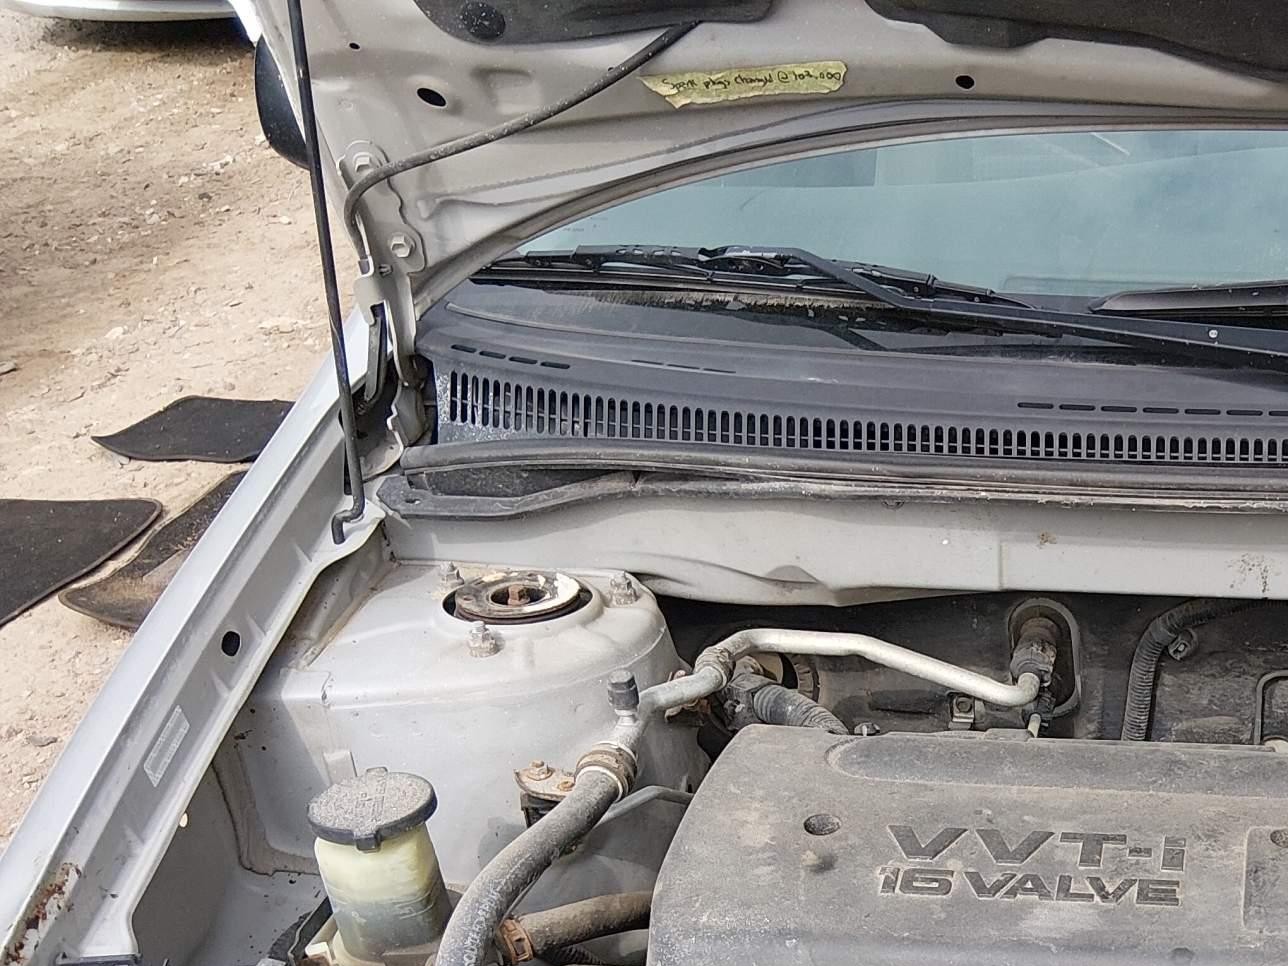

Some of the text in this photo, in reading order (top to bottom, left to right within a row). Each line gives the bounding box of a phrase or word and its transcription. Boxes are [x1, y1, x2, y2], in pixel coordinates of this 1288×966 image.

[777, 71, 790, 83] @
[887, 824, 1187, 872] VVT-i
[879, 865, 1182, 906] 16 VALVE
